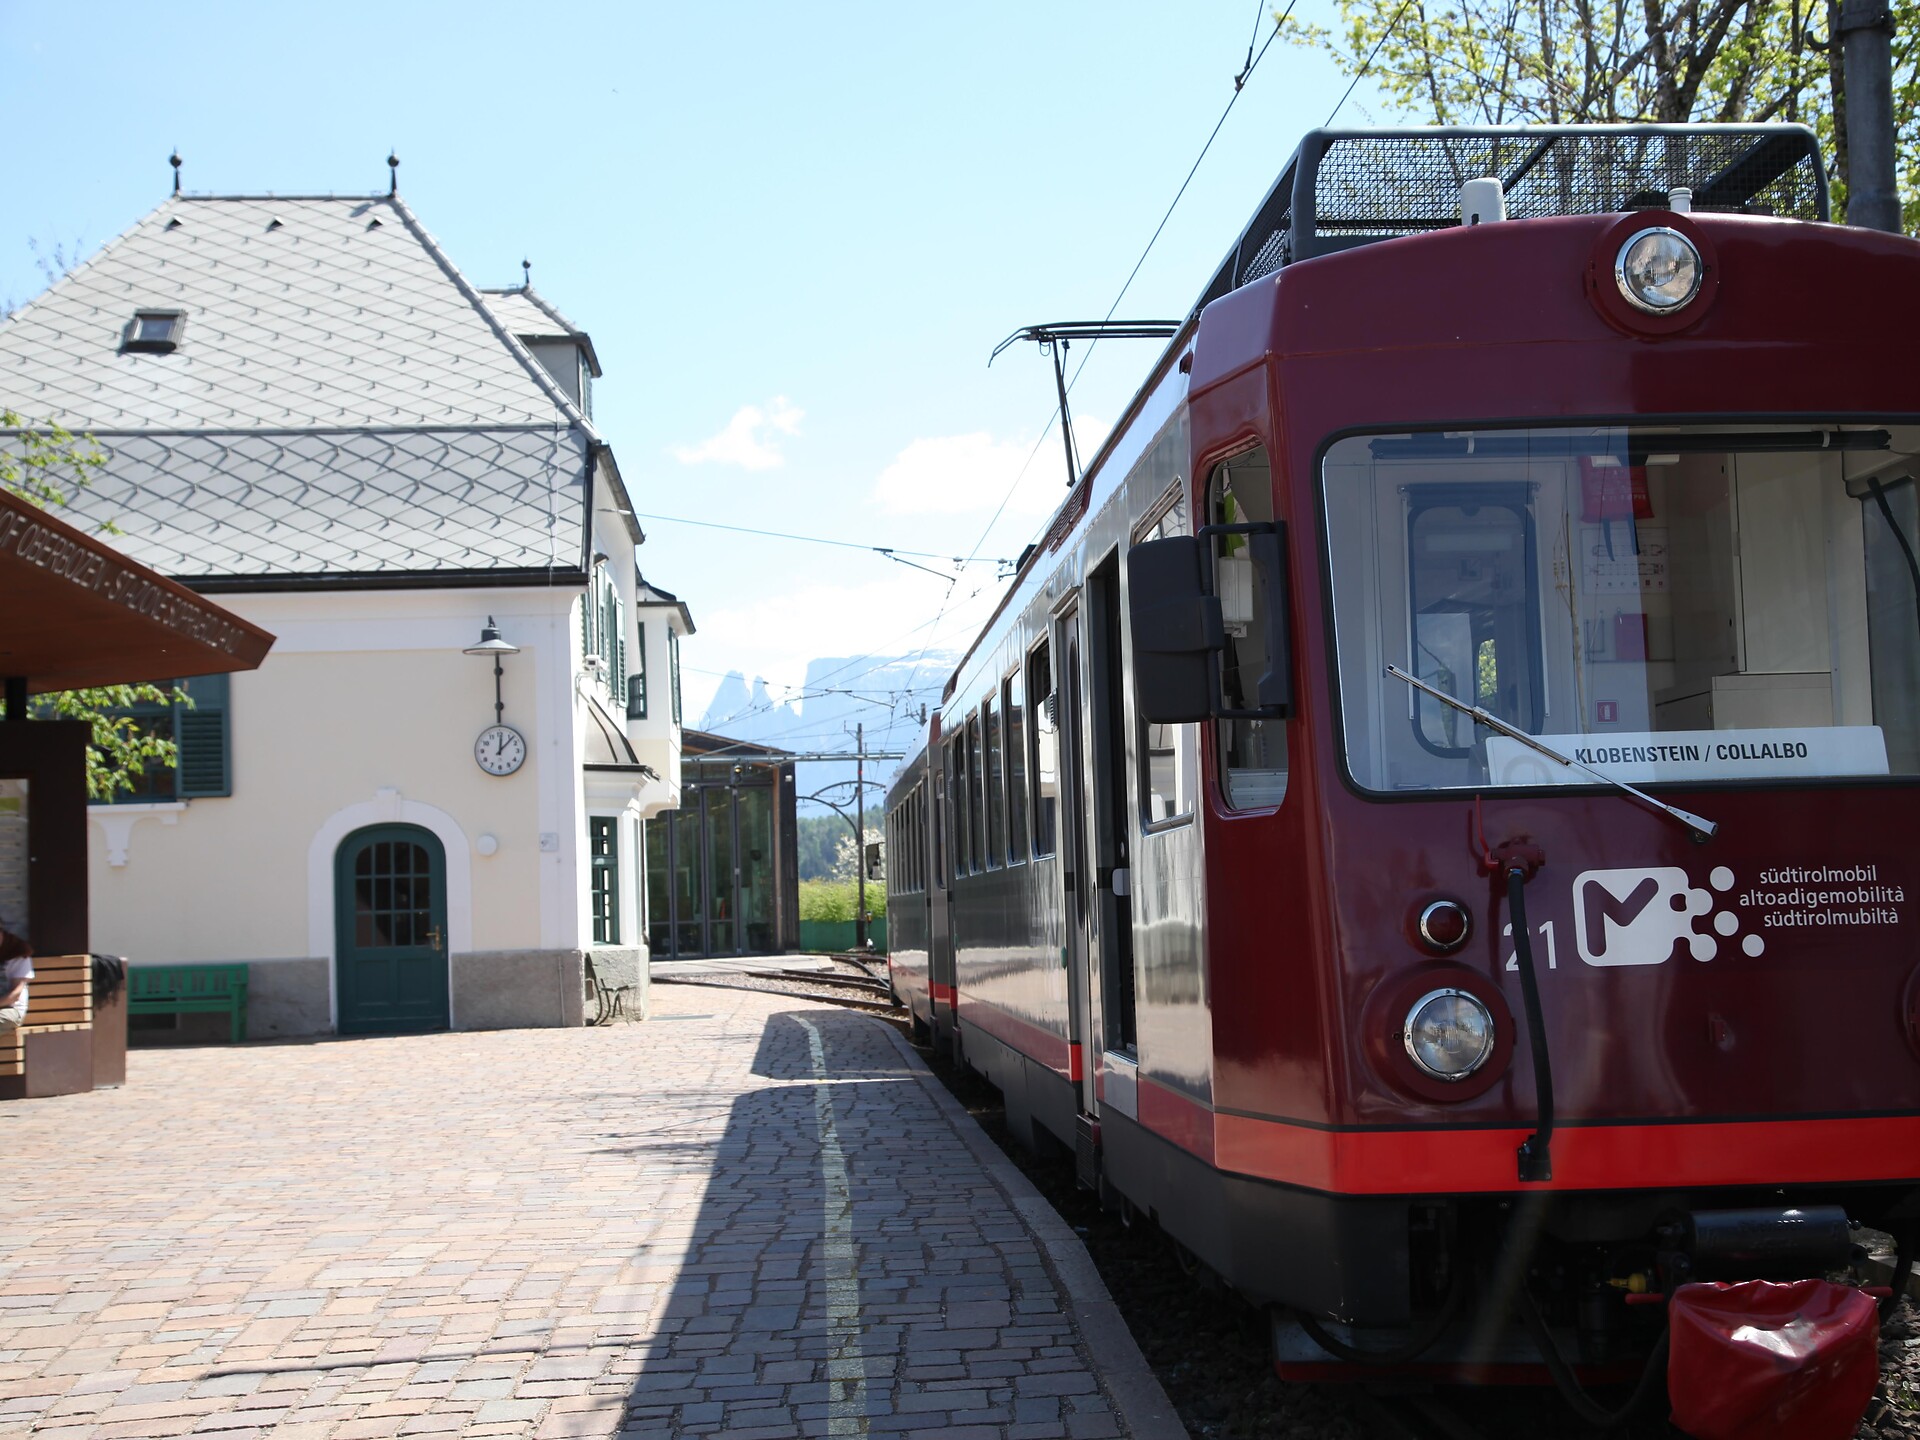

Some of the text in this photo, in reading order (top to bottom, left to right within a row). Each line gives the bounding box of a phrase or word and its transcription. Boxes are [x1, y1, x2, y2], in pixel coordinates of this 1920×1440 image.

[17, 523, 108, 591] OBERBOZEN
[108, 570, 173, 620] STAZIONE
[1575, 742, 1808, 764] KLOBENSTEIN / COLLALBO
[1759, 864, 1877, 884] südtirolmobil
[1739, 885, 1905, 908] altoadigemobilità
[1764, 907, 1899, 927] südtirolmubiltà
